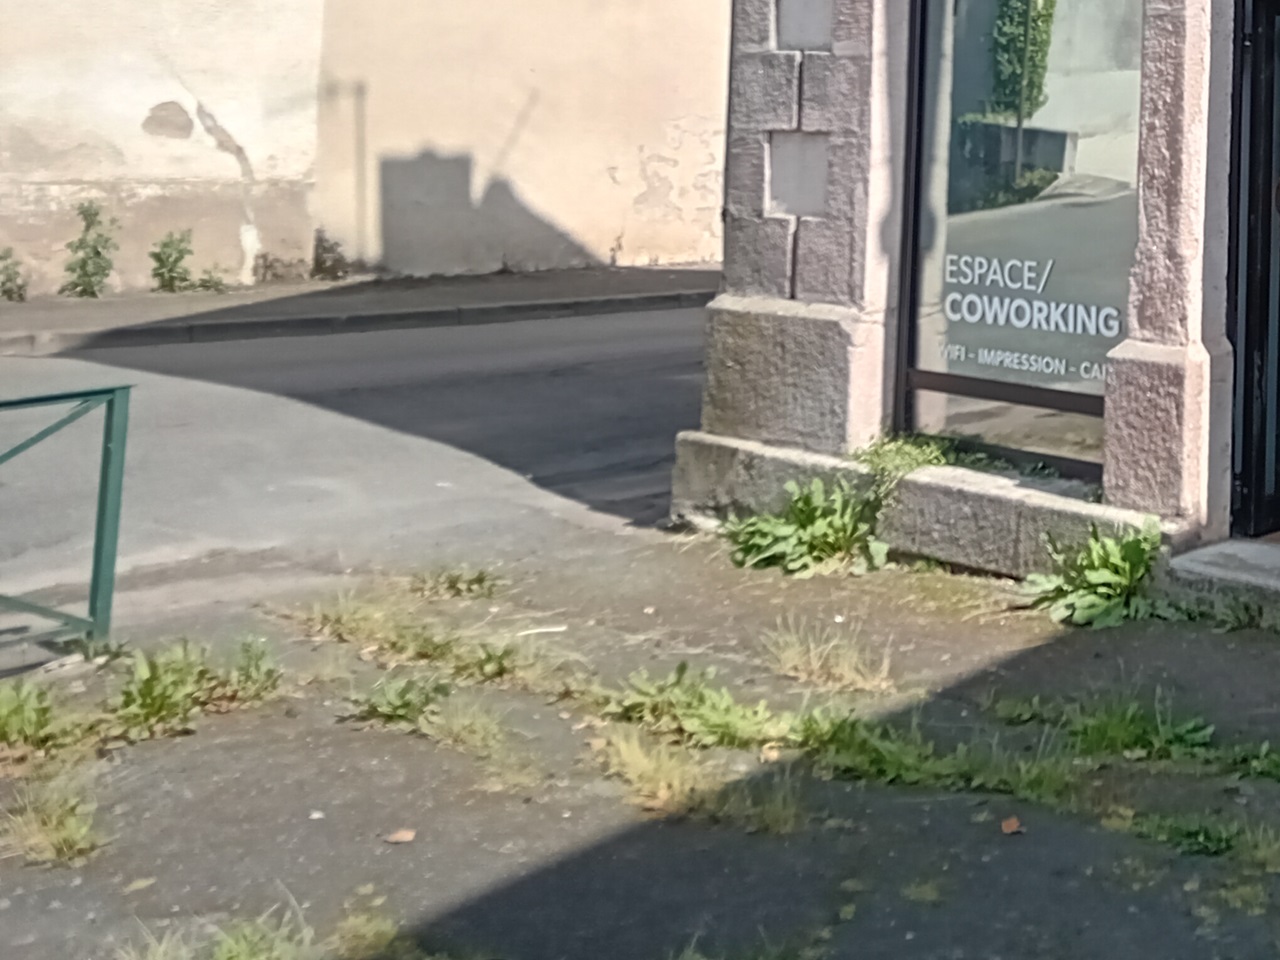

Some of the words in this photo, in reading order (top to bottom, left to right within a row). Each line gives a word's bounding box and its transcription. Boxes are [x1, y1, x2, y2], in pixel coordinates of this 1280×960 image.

[945, 254, 1055, 294] ESPACE/
[944, 292, 1121, 338] COWORKING
[977, 348, 1067, 376] IMPRESSION
